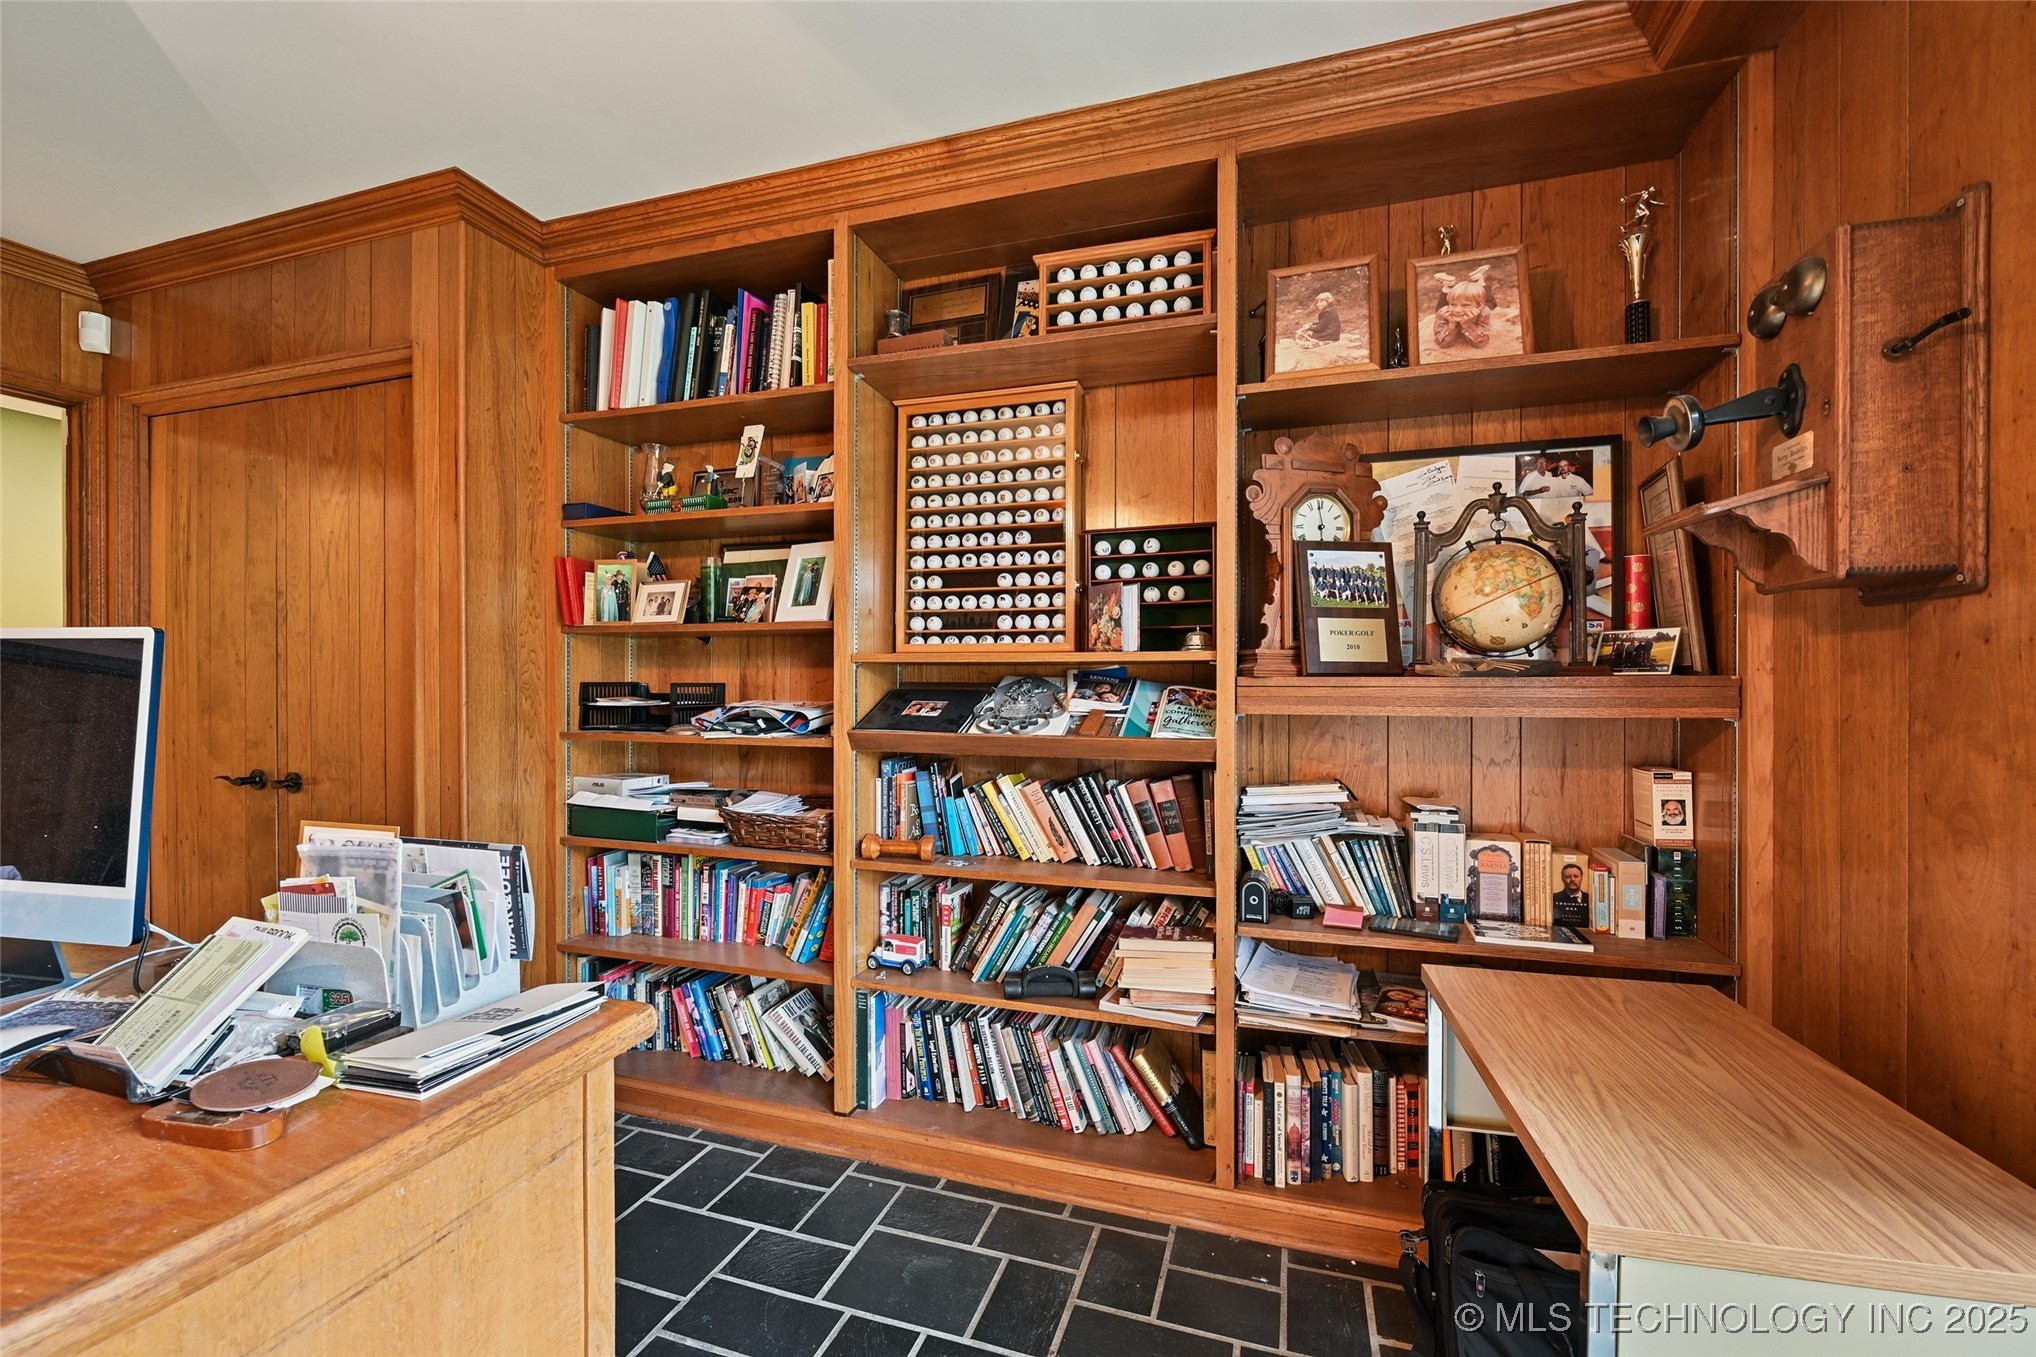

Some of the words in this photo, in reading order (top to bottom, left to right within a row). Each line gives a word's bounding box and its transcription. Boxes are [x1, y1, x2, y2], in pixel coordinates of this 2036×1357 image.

[1163, 715, 1217, 727] Gathered
[1165, 710, 1213, 719] COMMUNITY
[976, 903, 990, 925] SUMMONS
[963, 934, 973, 947] JOHN
[954, 946, 968, 965] GRISHAM
[782, 1003, 797, 1018] THE
[794, 991, 815, 1011] CHOICE
[805, 1053, 822, 1070] CHOICE
[977, 1064, 987, 1084] PAINS
